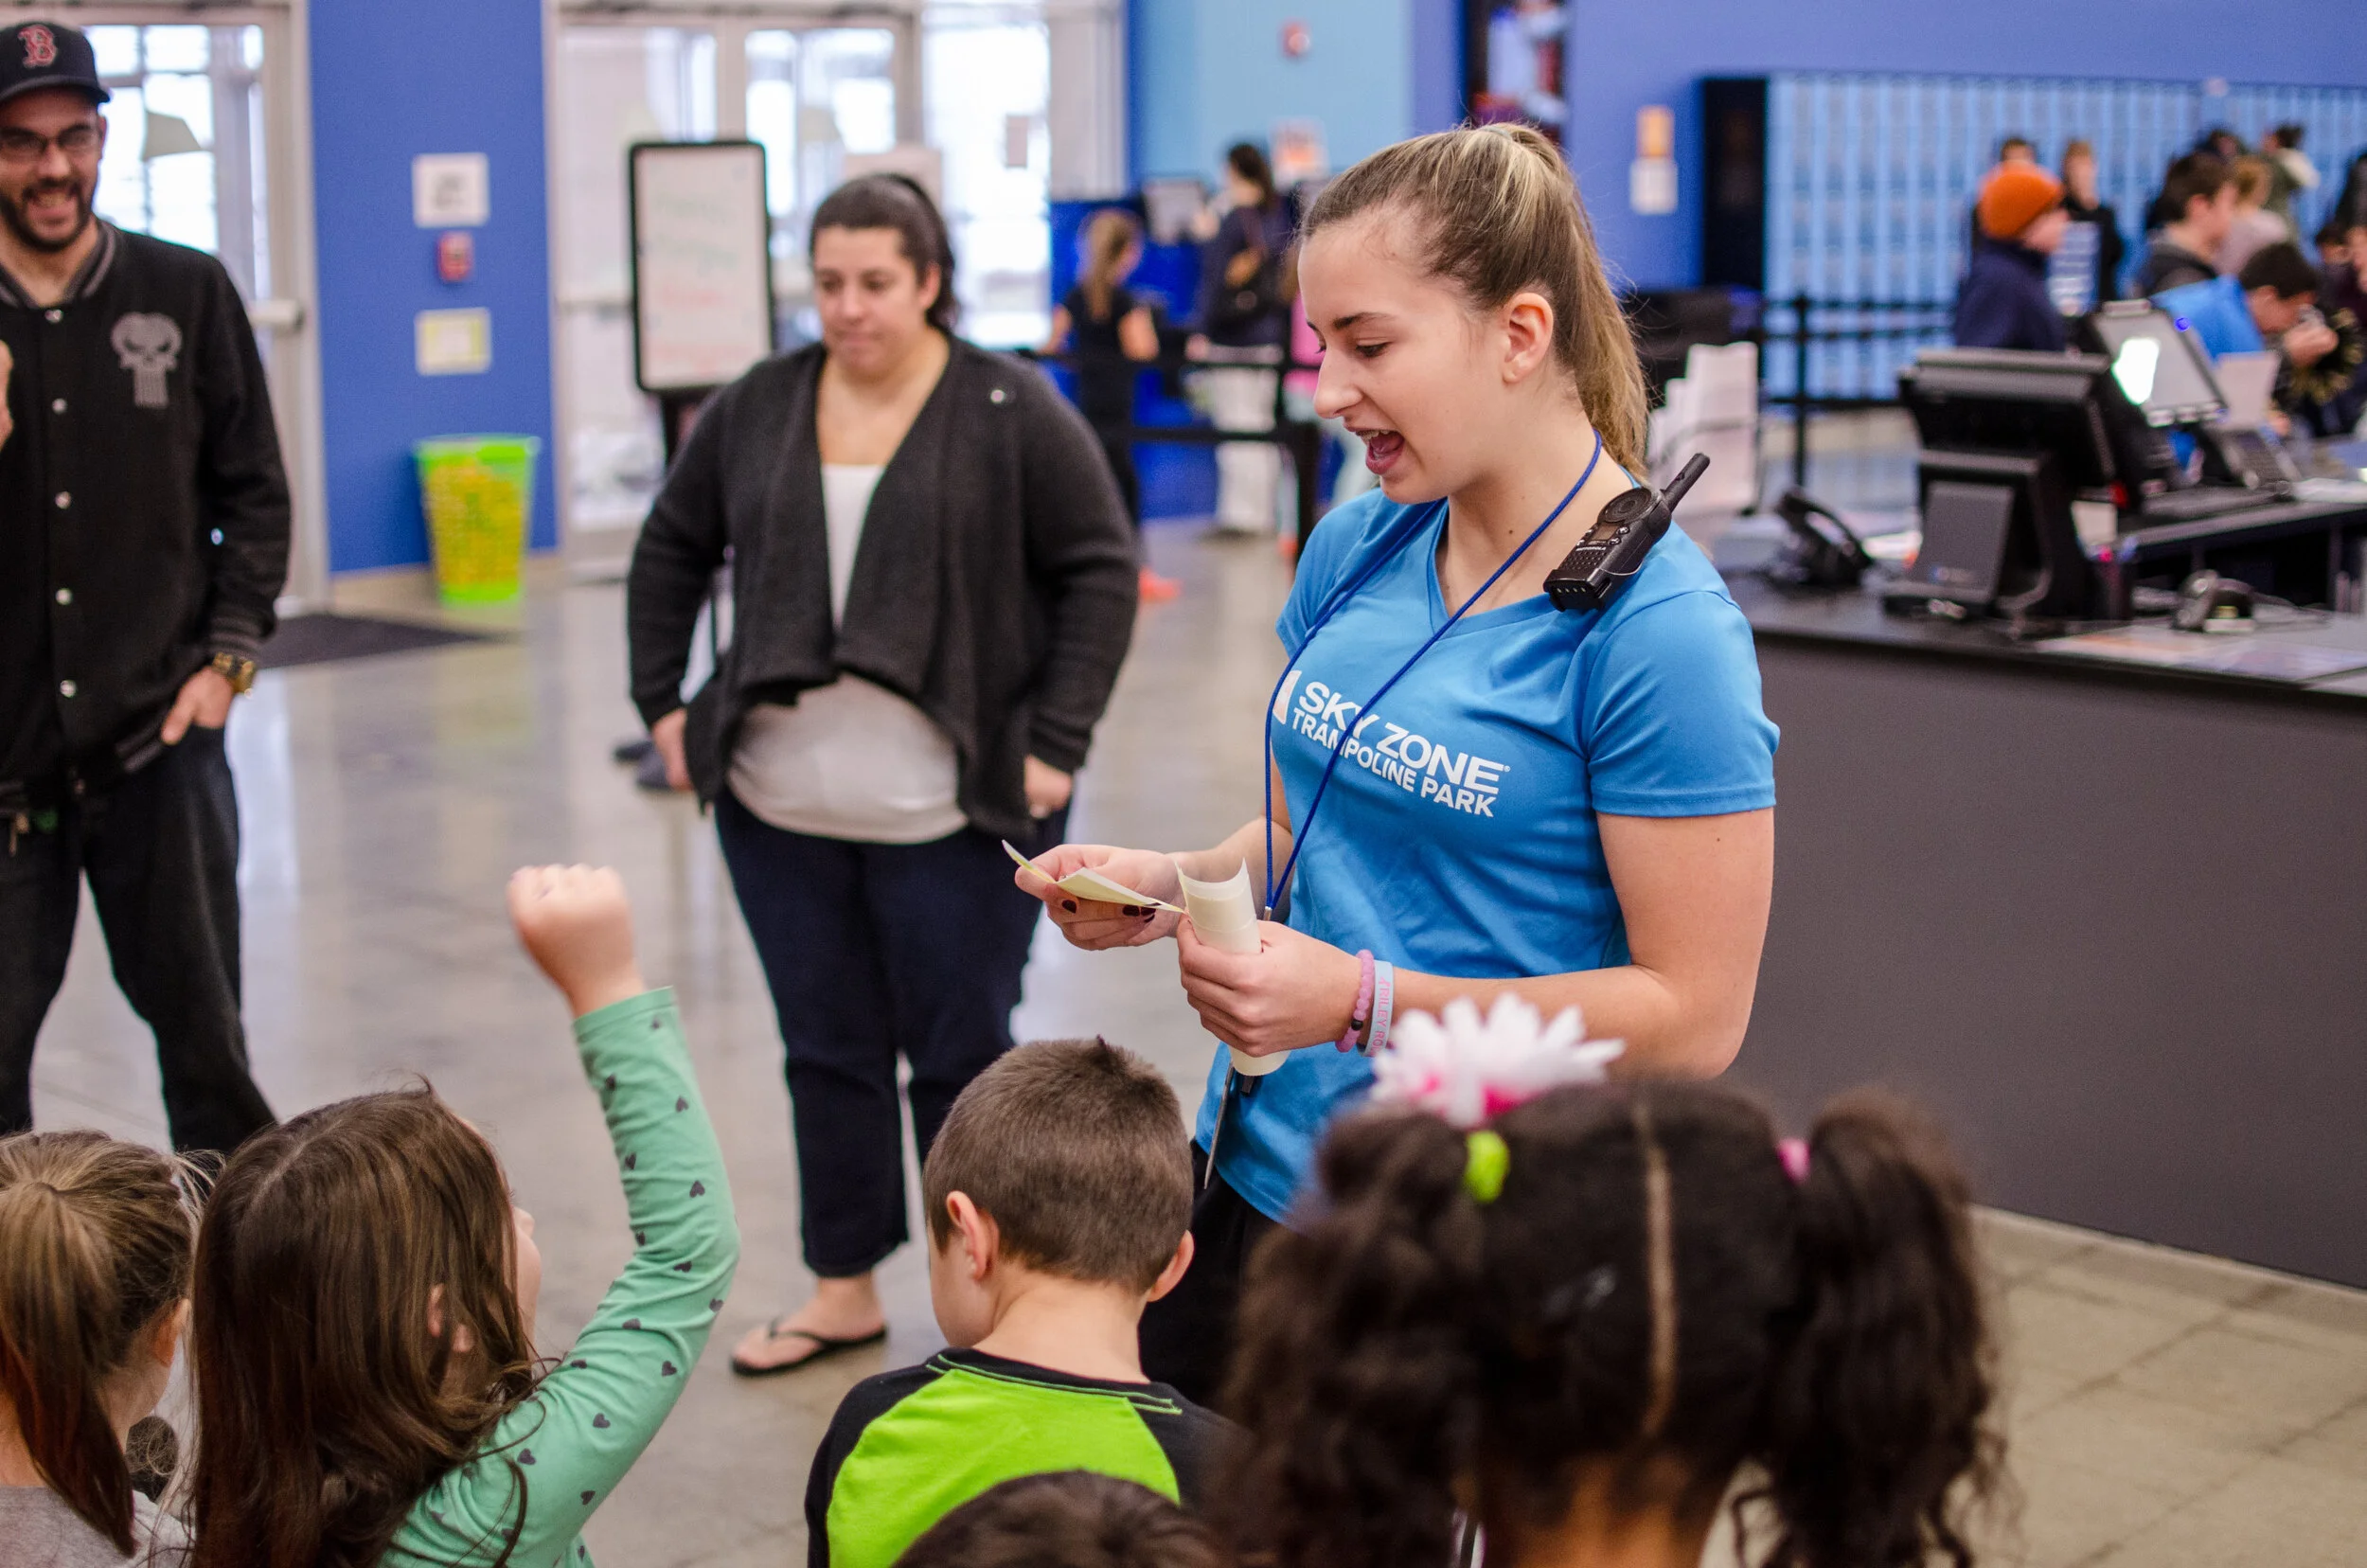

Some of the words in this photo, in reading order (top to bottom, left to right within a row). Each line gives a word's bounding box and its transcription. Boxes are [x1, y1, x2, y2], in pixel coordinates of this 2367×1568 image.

[18, 24, 57, 69] B
[1298, 682, 1379, 739] SKY
[1376, 722, 1504, 795] ZONE
[1420, 776, 1497, 818] PARK
[1376, 988, 1390, 1027] RILEY
